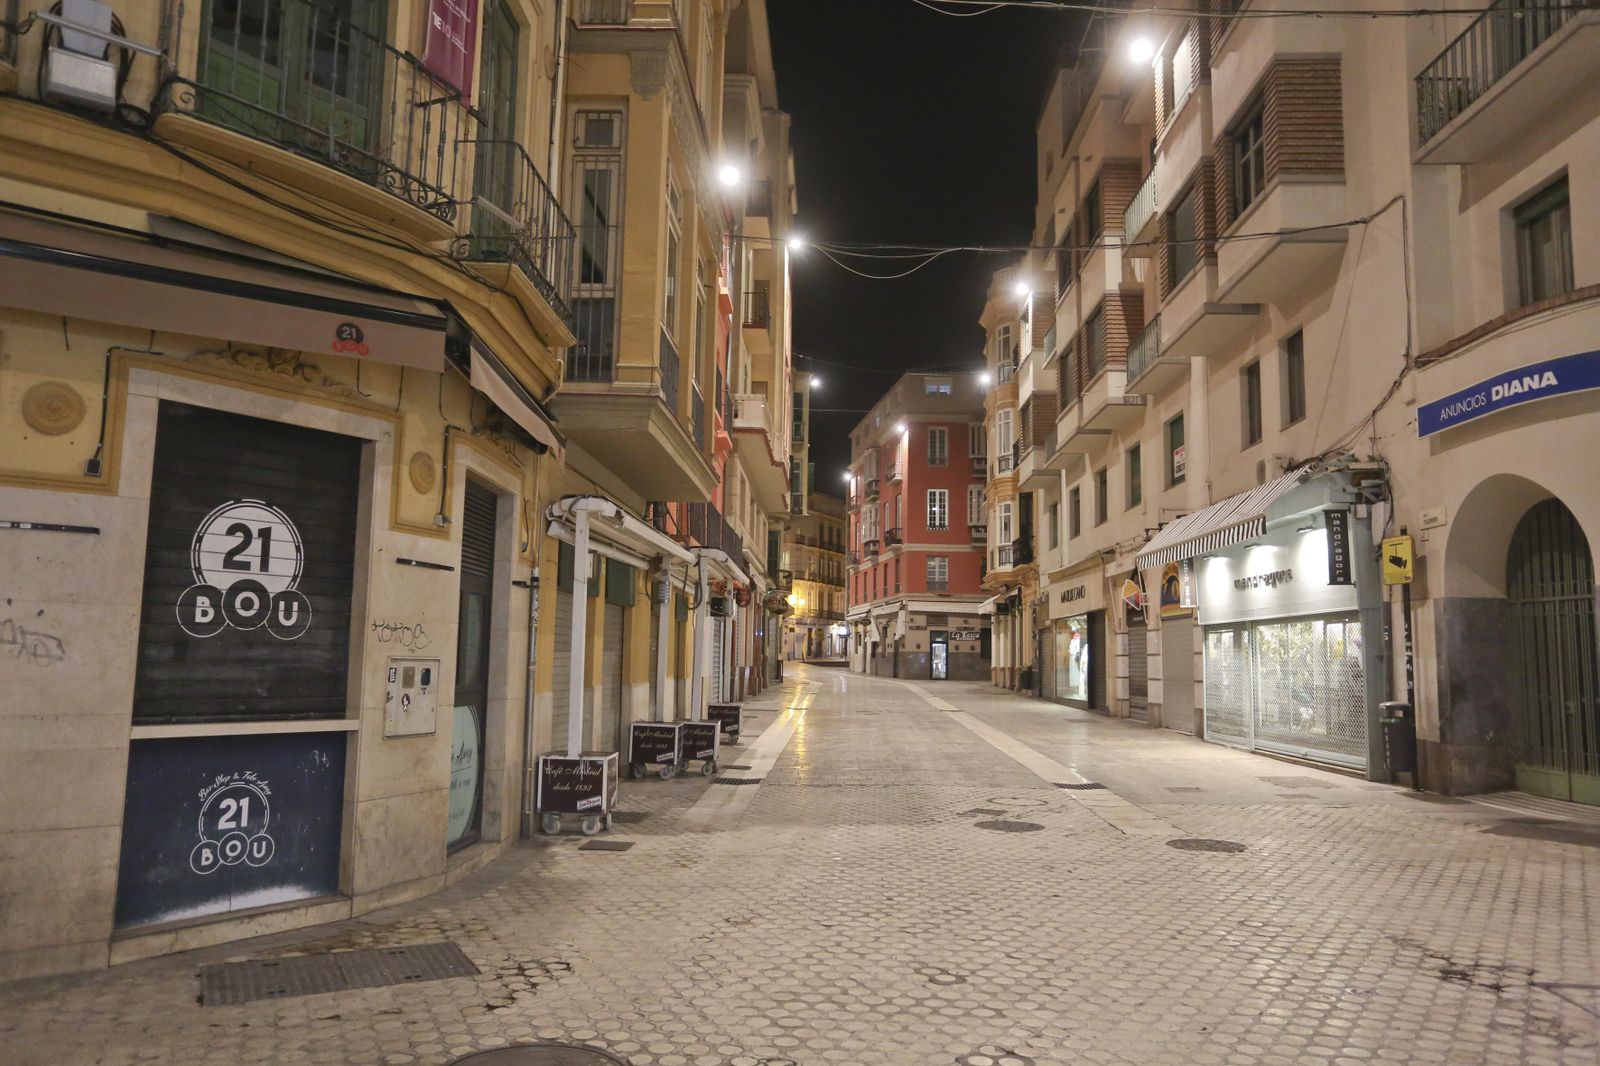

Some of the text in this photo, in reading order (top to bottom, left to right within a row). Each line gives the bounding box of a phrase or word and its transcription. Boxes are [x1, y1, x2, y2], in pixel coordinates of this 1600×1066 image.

[342, 327, 357, 339] 21
[1440, 371, 1558, 421] ANUNCIOS DIANA
[223, 522, 272, 573] 21
[1331, 512, 1345, 583] mandragora
[195, 591, 299, 627] BOU
[553, 782, 593, 792] desde 1892
[566, 765, 602, 776] Madrid
[217, 796, 250, 830] 21
[201, 840, 266, 866] BOU
